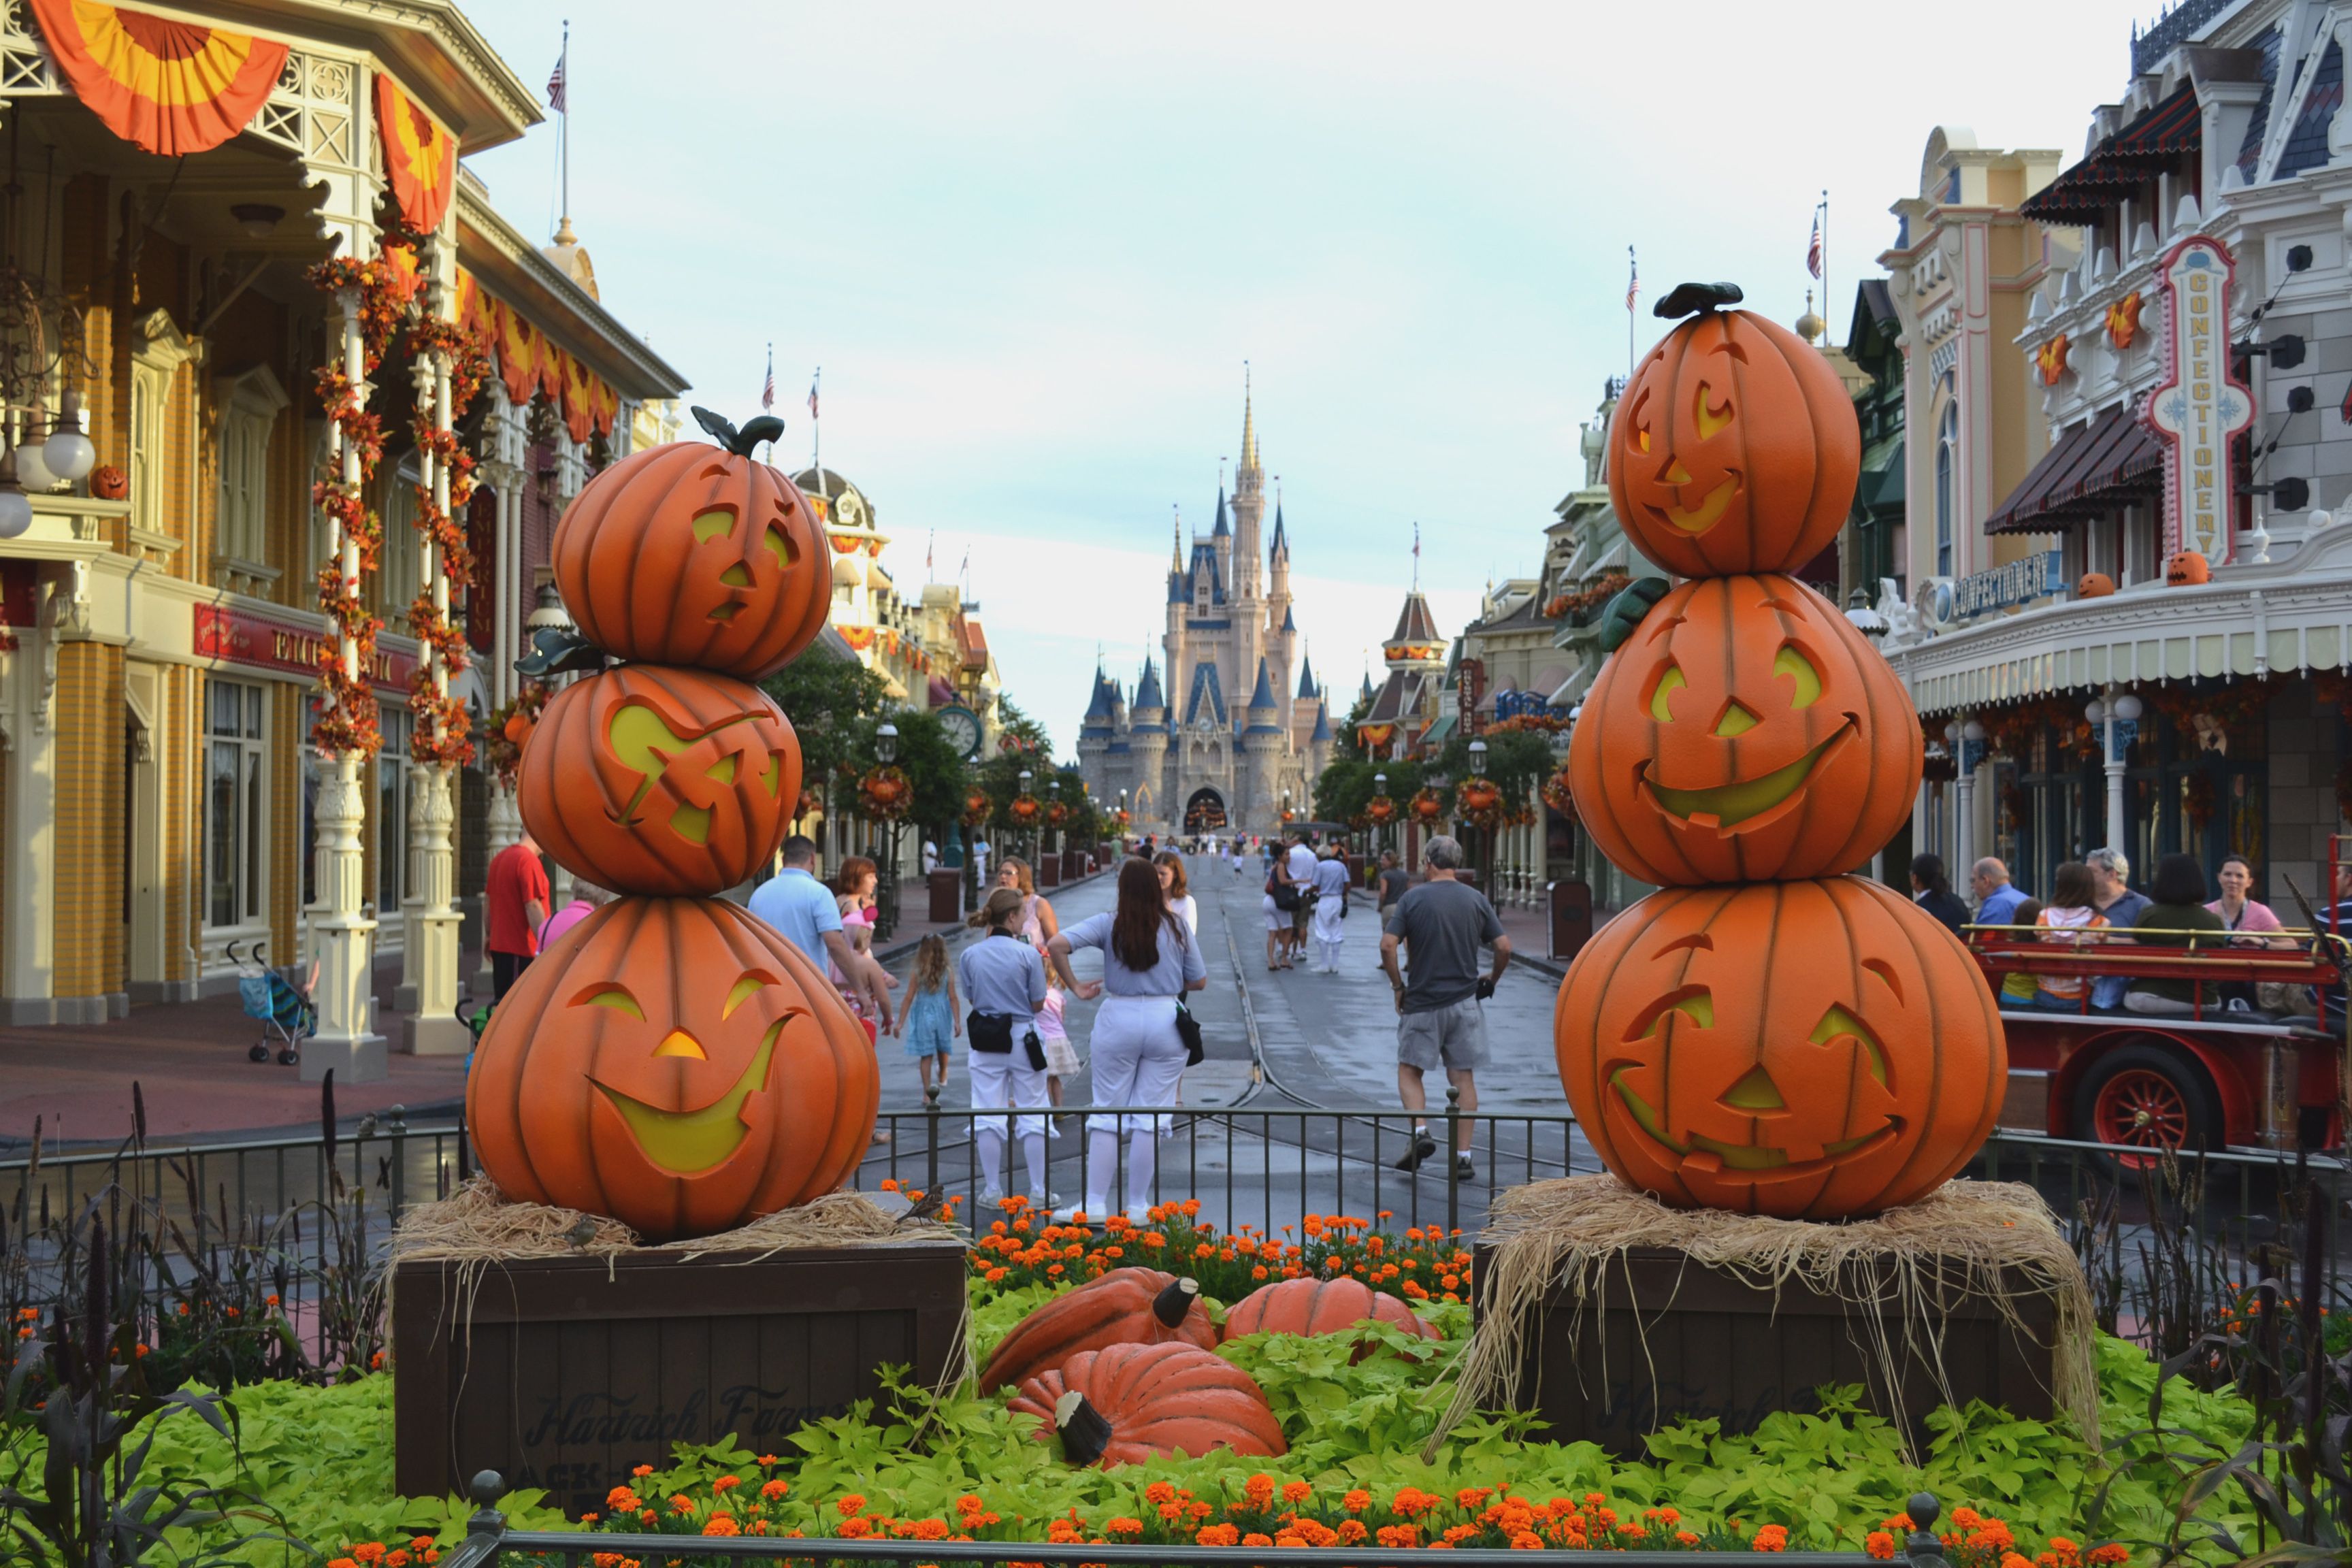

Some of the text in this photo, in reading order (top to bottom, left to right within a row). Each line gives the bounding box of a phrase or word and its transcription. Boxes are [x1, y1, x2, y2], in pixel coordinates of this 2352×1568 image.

[2189, 274, 2215, 553] CONFECTIONERY
[476, 503, 491, 632] EMPORIUM
[1953, 552, 2048, 617] CONFECTIONERY
